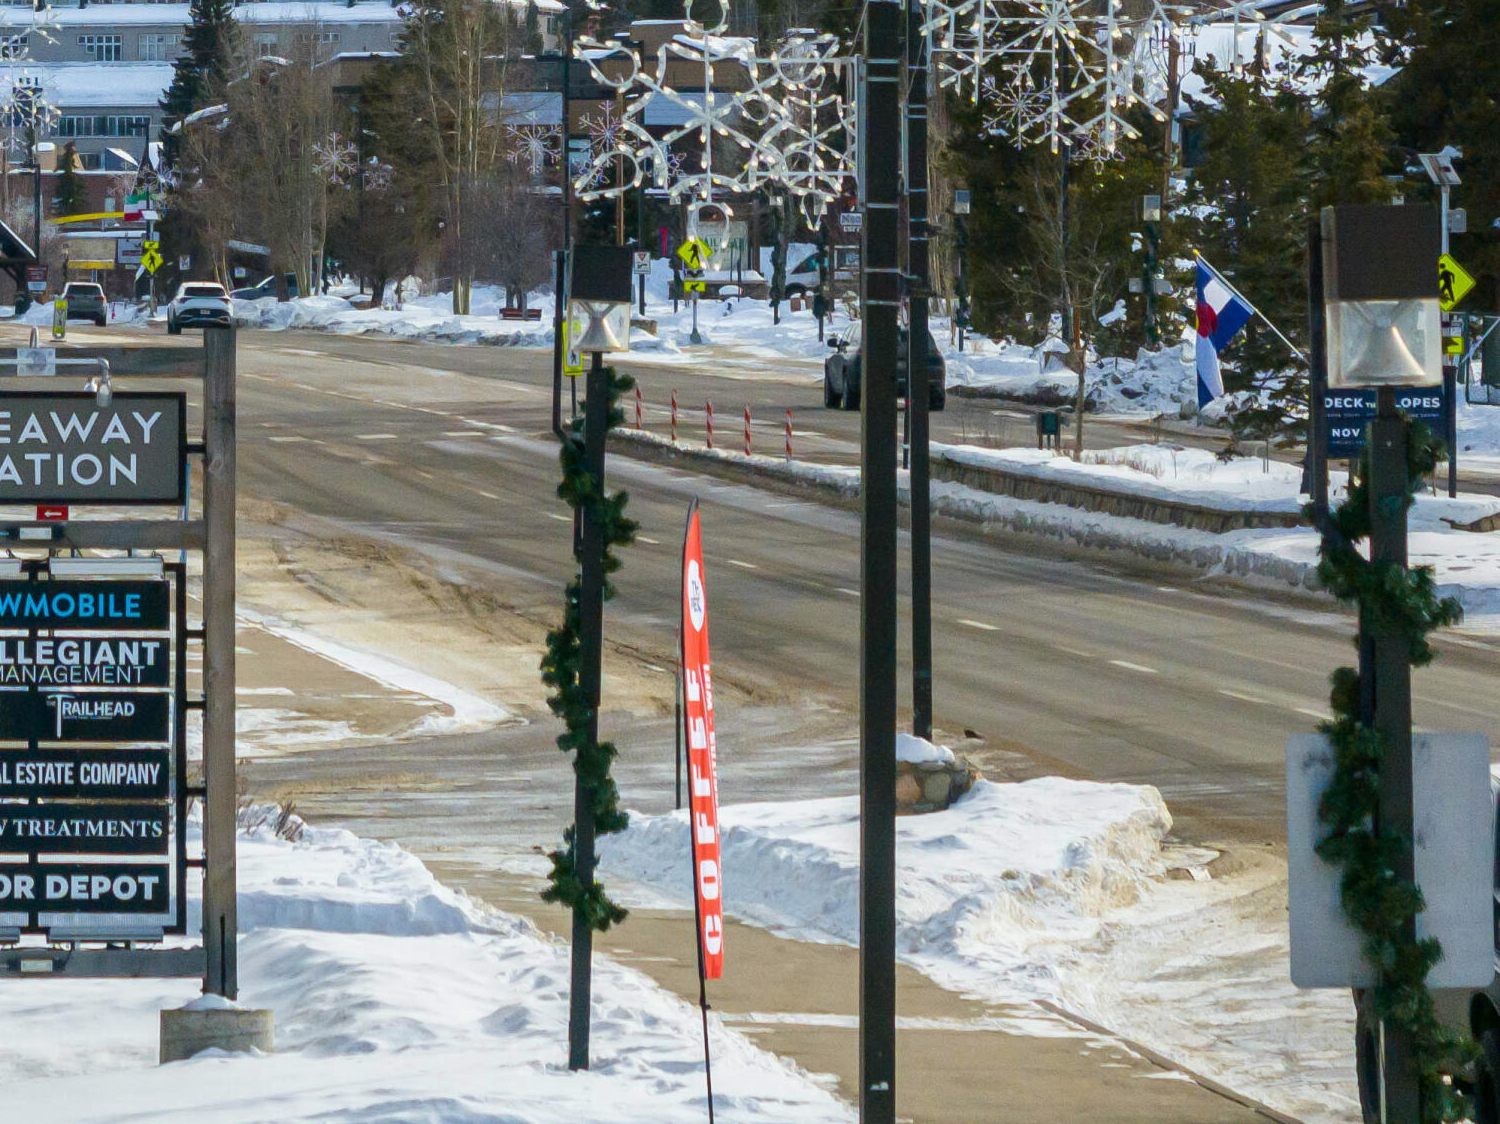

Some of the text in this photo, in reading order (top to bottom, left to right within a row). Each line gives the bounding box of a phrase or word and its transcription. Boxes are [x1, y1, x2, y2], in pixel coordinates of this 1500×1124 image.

[1332, 427, 1360, 437] NOV
[47, 693, 133, 737] TRAILHEAD
[16, 761, 72, 783] ESTATE
[80, 761, 158, 784] COMPANY
[13, 818, 161, 836] TREATMENTS
[46, 874, 158, 899] DEPOT
